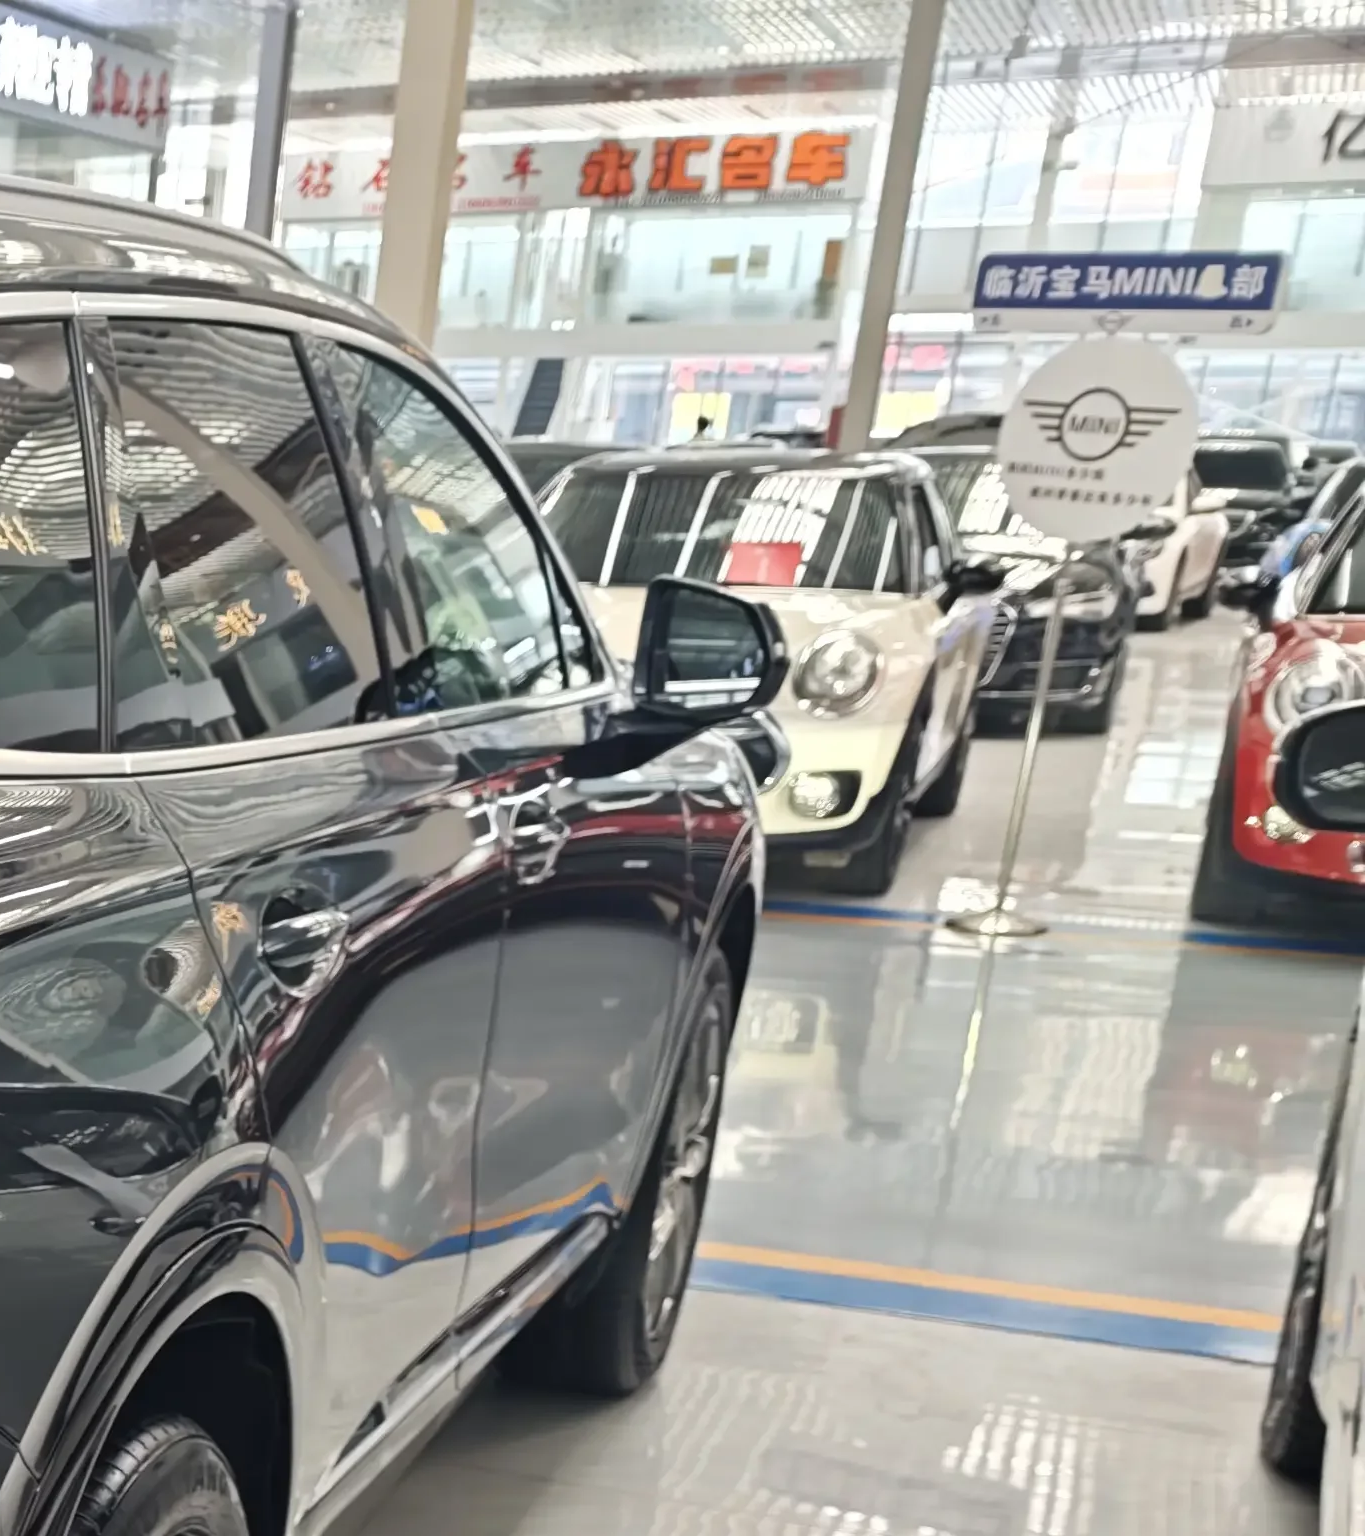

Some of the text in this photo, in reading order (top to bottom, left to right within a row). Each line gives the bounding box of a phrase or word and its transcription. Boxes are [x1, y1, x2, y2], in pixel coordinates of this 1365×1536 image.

[577, 129, 851, 197] 永汇名车
[982, 263, 1267, 299] 临沂宝马MINI部
[1069, 414, 1121, 436] MINI
